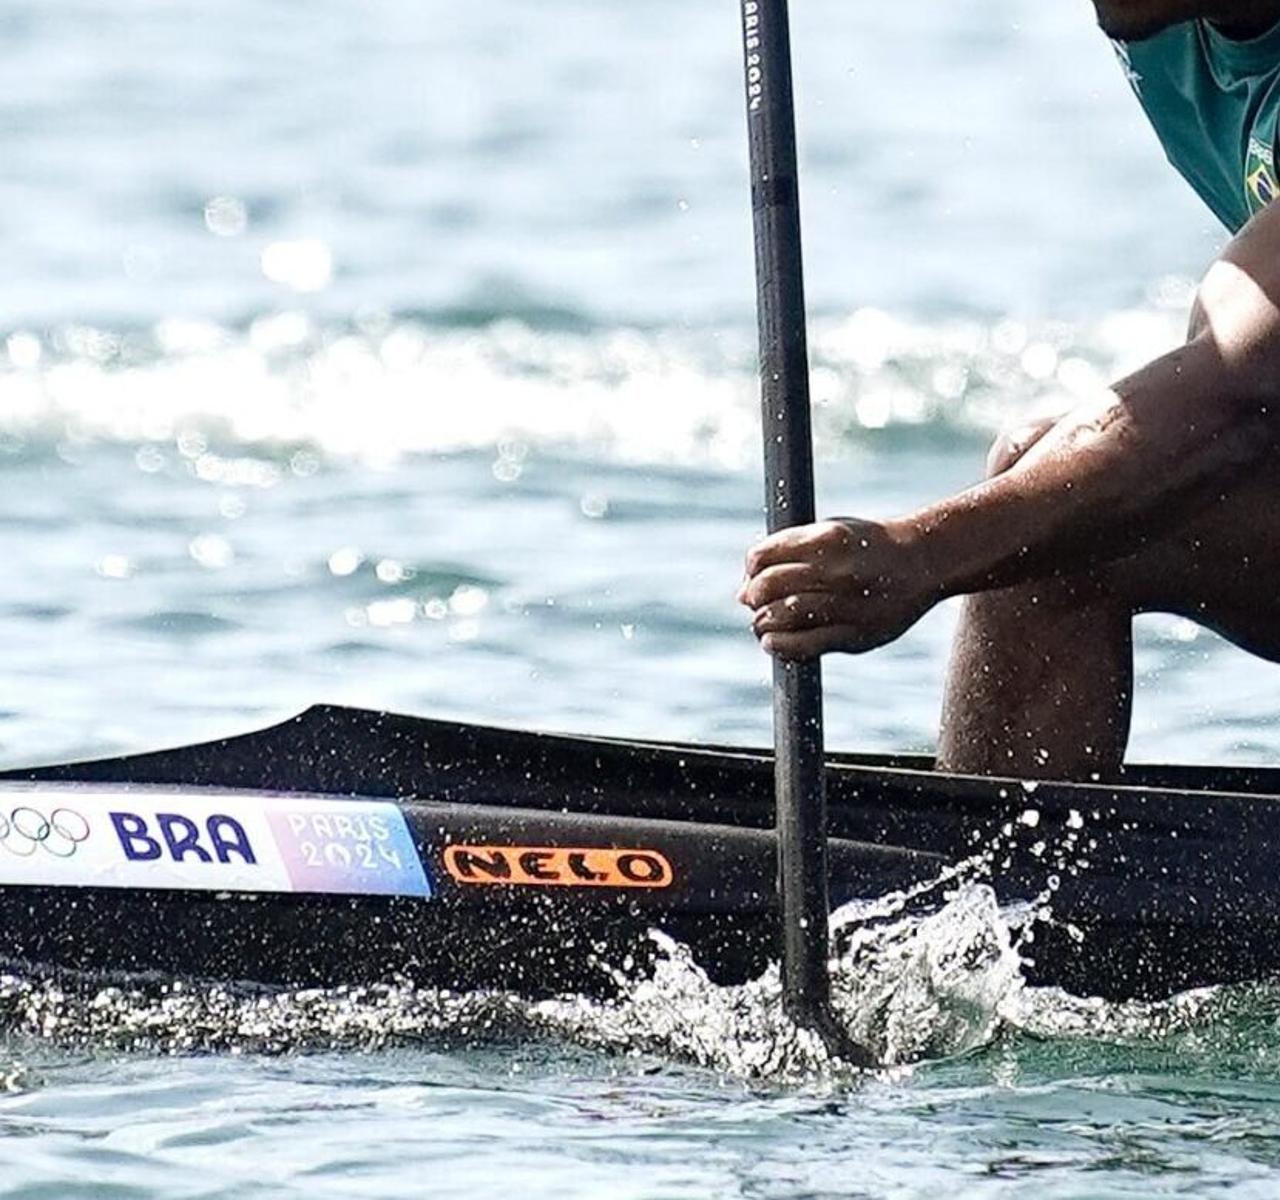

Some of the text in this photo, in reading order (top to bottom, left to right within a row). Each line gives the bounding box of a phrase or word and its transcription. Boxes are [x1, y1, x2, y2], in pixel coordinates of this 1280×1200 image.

[747, 54, 762, 110] 2024
[109, 811, 257, 865] BRA
[287, 816, 389, 843] PARIS
[303, 842, 399, 870] 2024
[452, 849, 665, 883] NELO
